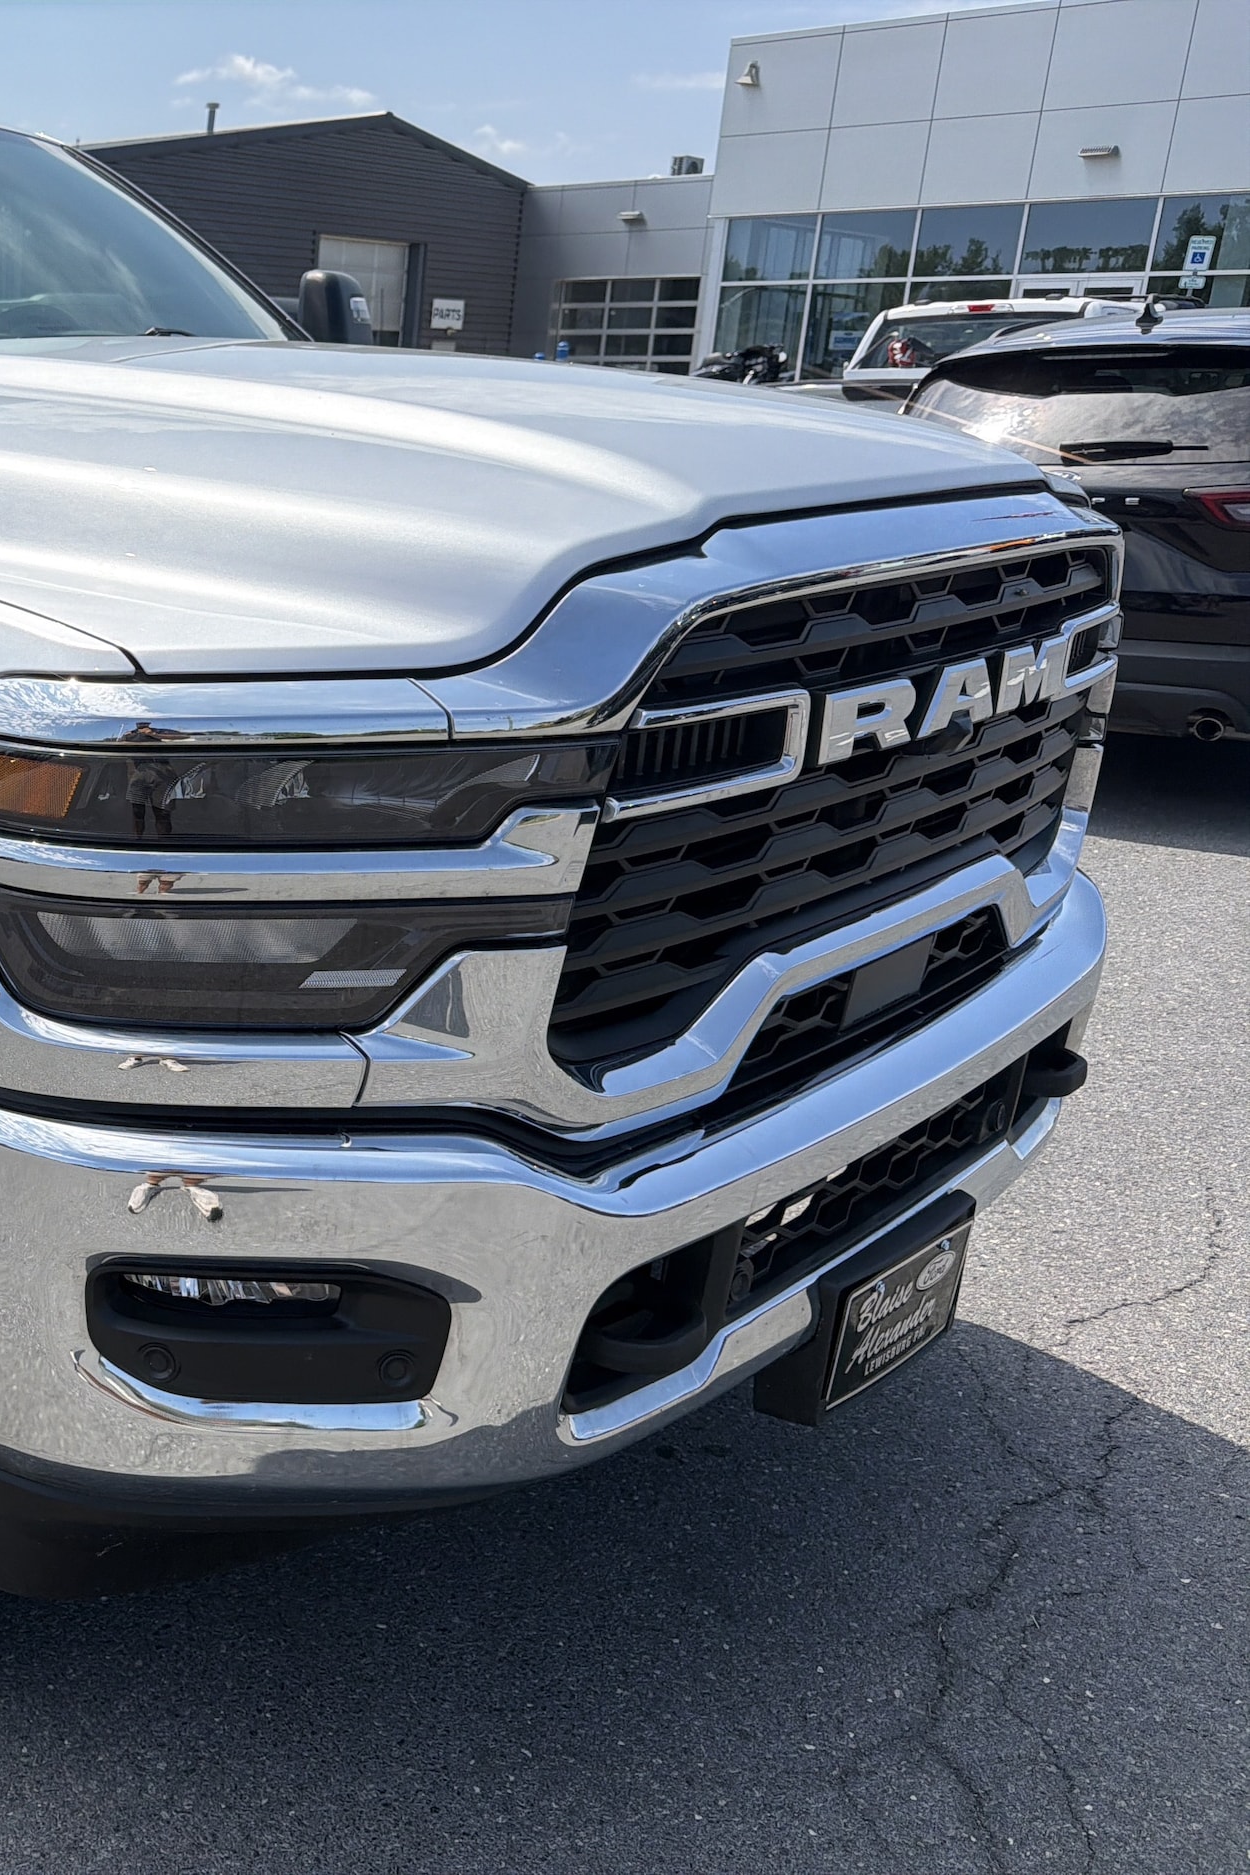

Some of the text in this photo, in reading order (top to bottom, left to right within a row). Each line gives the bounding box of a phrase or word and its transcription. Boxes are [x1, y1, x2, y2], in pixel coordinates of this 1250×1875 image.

[433, 307, 461, 321] PARTS
[817, 634, 1069, 766] RAM
[857, 1281, 914, 1332] Blaise
[845, 1294, 936, 1374] Alexander
[864, 1335, 912, 1376] LEWISBURG
